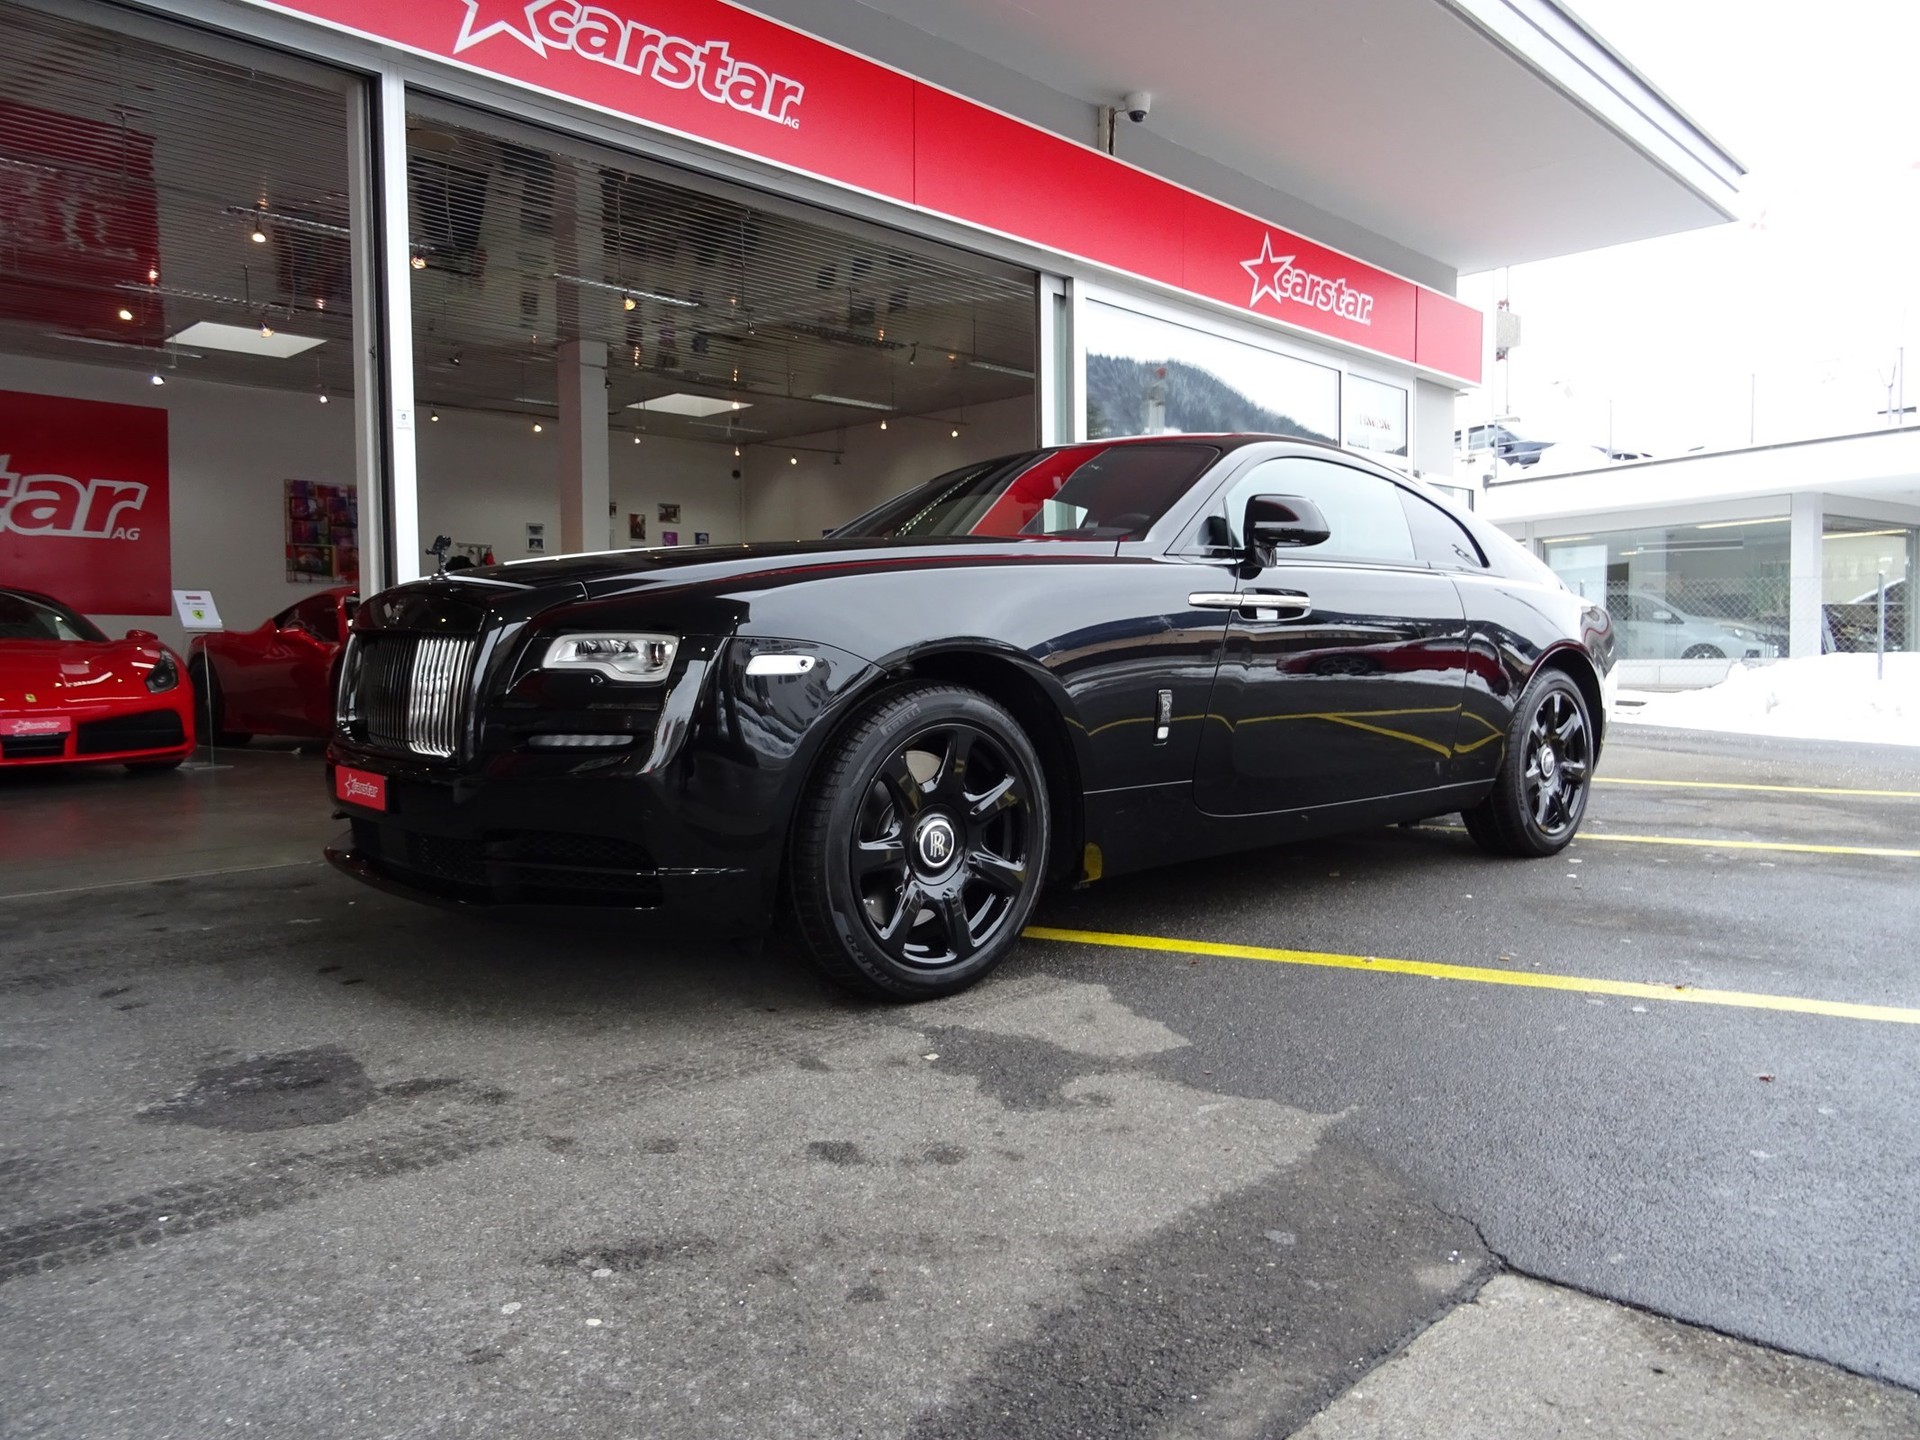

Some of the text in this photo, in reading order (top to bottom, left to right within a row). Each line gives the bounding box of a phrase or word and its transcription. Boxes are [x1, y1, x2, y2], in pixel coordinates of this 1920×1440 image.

[524, 0, 804, 129] carstar AG
[1273, 265, 1374, 324] carstar
[111, 527, 140, 541] AG
